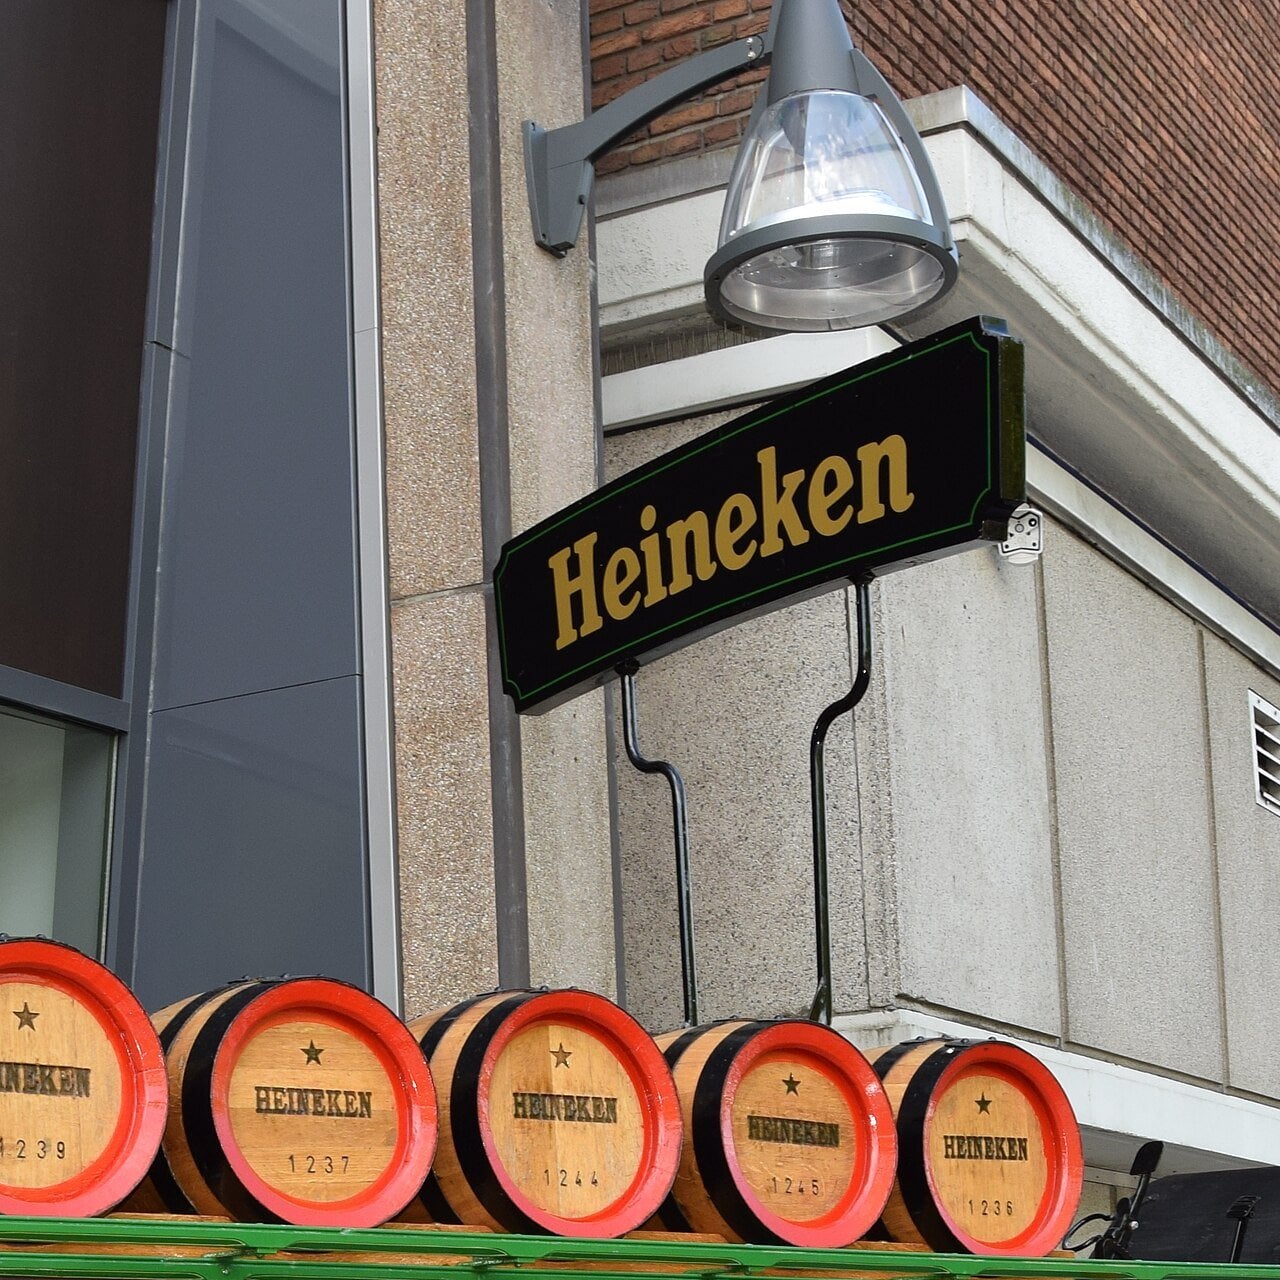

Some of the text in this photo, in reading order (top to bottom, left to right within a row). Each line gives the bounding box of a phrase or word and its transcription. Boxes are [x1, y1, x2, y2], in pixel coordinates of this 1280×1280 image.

[548, 433, 915, 651] Heineken
[255, 1086, 372, 1118] HEINEKEN
[513, 1092, 618, 1123] HEINEKEN
[747, 1115, 840, 1147] HEINEKEN
[943, 1135, 1028, 1161] HEINEKEN
